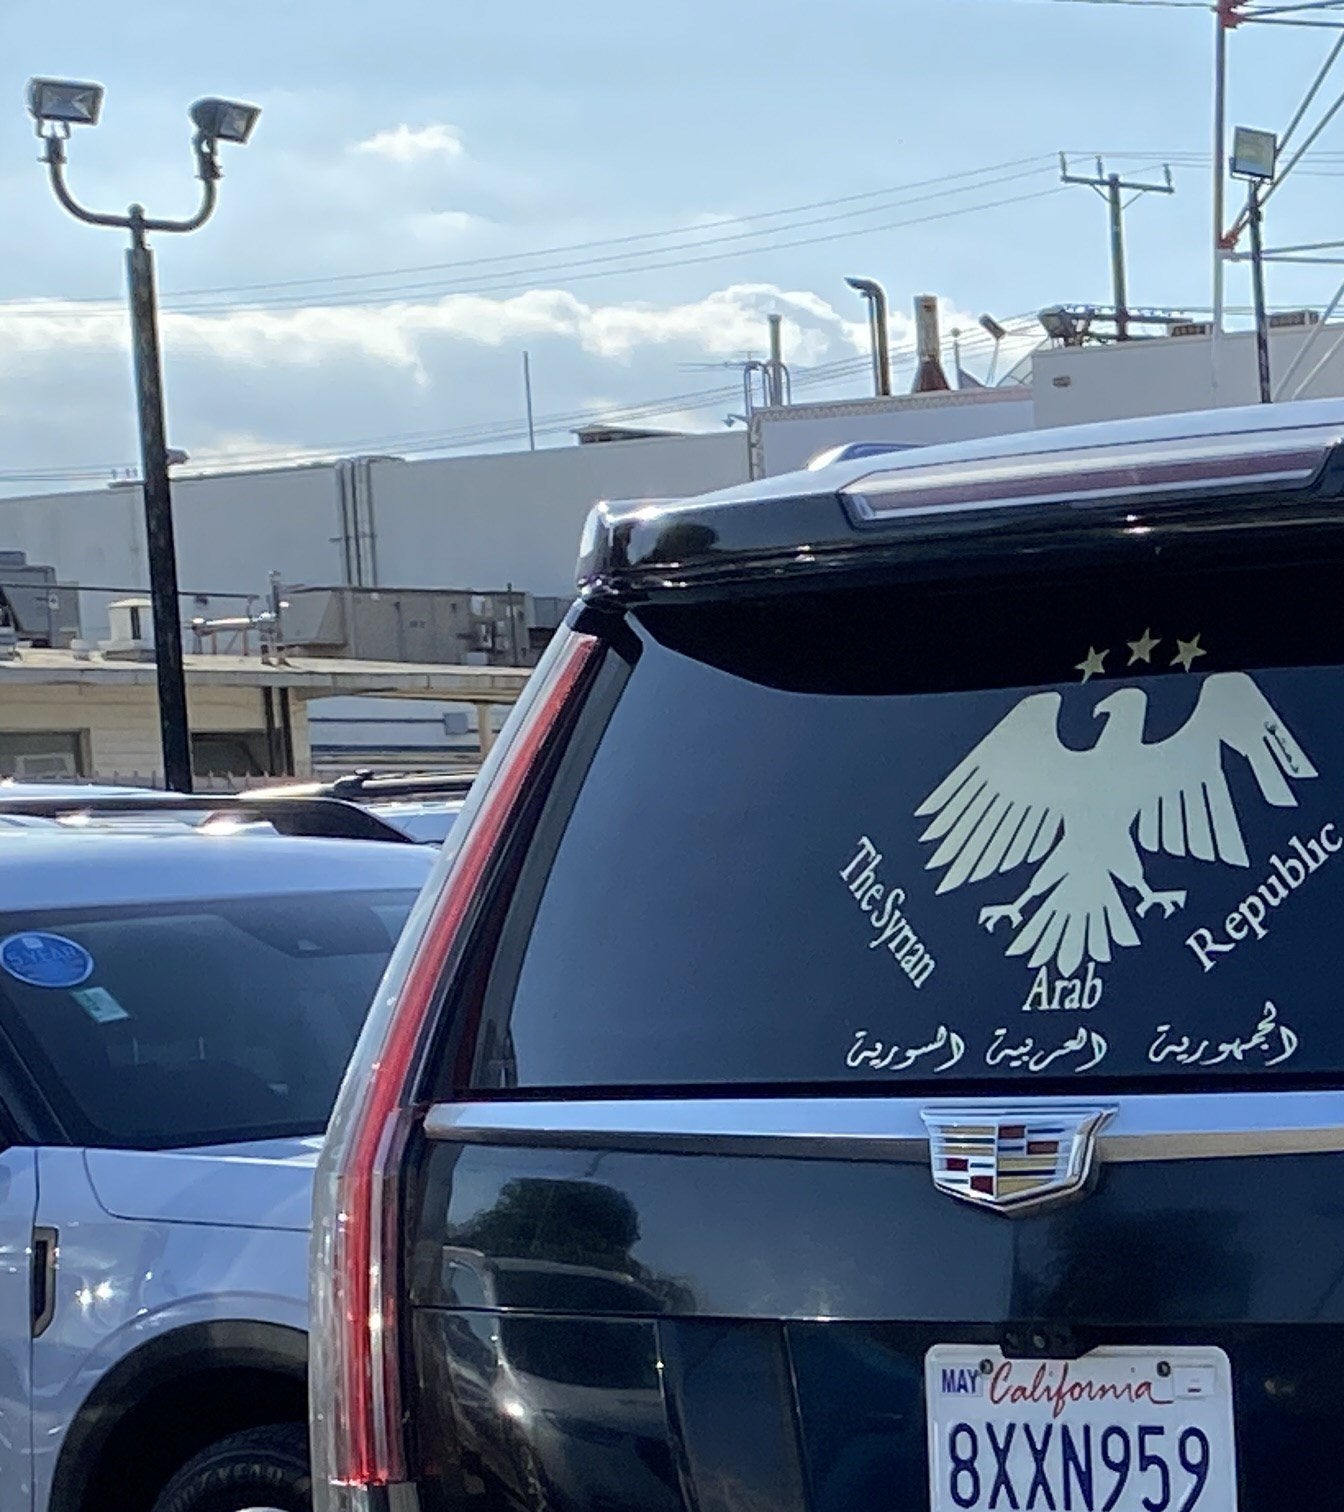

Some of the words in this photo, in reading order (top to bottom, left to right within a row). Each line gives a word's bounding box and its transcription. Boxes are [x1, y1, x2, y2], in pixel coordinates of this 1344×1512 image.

[1185, 822, 1344, 973] Republic
[1022, 962, 1102, 1011] Arab
[846, 1026, 965, 1071] السورية
[986, 1027, 1108, 1072] العربية
[1148, 1001, 1297, 1066] الجمهورية
[941, 1368, 979, 1394] MAY
[989, 1361, 1174, 1417] California
